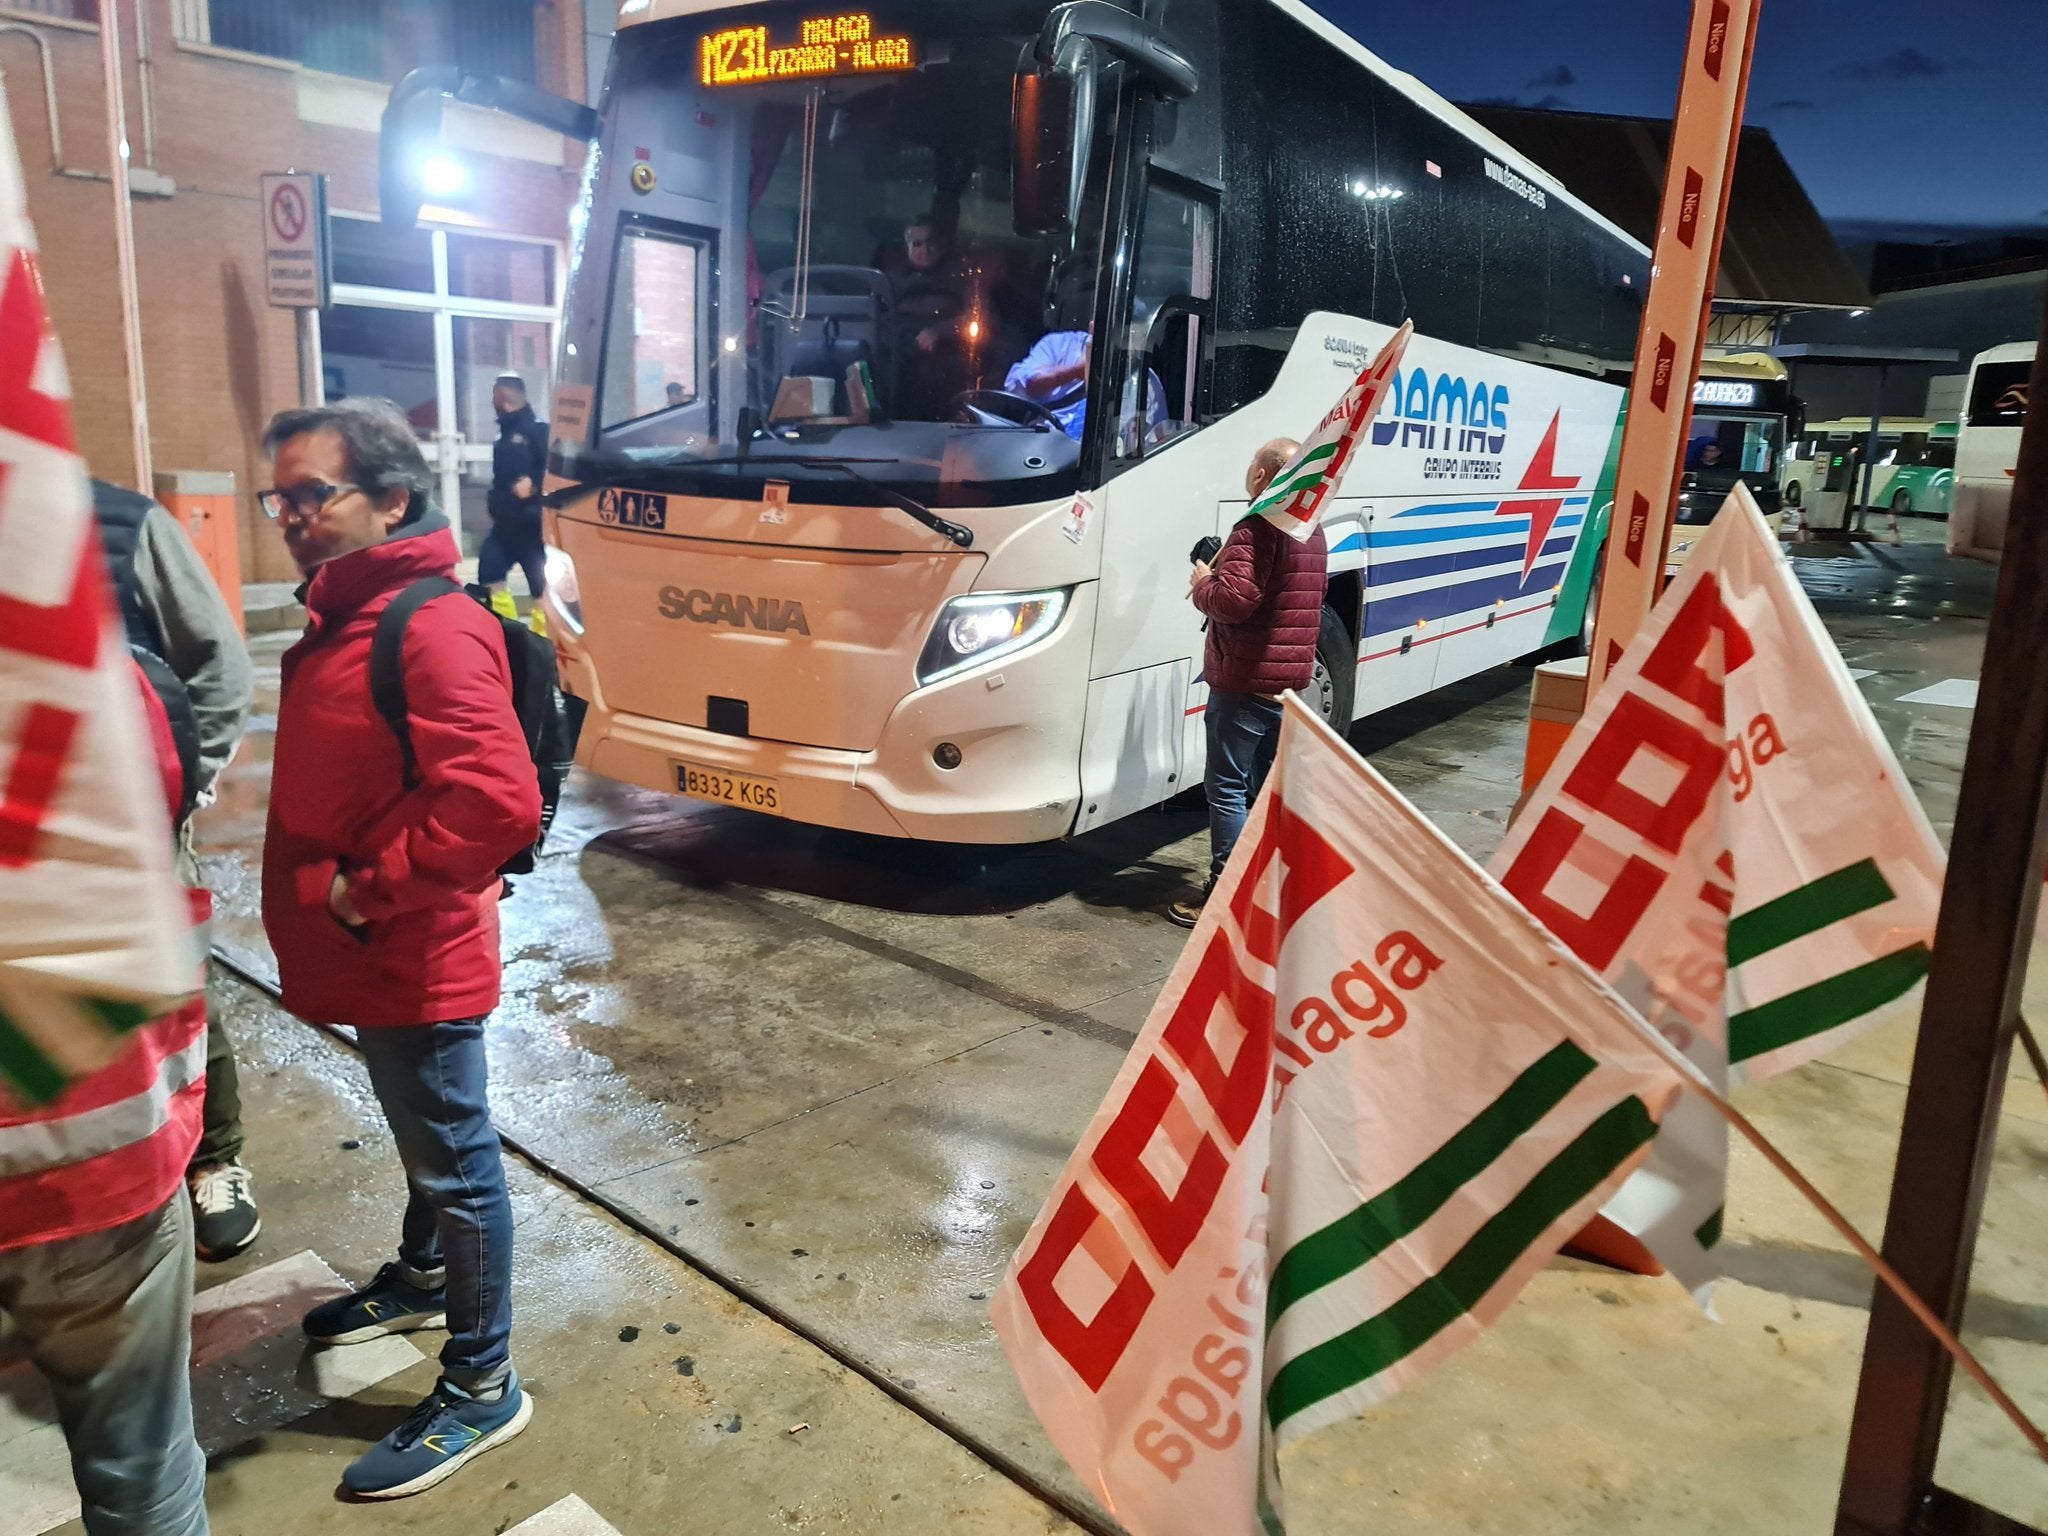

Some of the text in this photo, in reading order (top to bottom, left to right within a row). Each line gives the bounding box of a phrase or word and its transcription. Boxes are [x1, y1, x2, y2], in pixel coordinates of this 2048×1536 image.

[1708, 22, 1725, 54] Nice
[702, 27, 768, 86] M231
[1682, 193, 1697, 223] Nice
[1655, 358, 1671, 387] Nice
[1371, 367, 1510, 454] DAMAS
[1424, 457, 1502, 480] GRUPO INTERBUS
[1630, 515, 1645, 542] Nice
[657, 585, 811, 636] SCANIA
[688, 771, 777, 808] 8332 KGS
